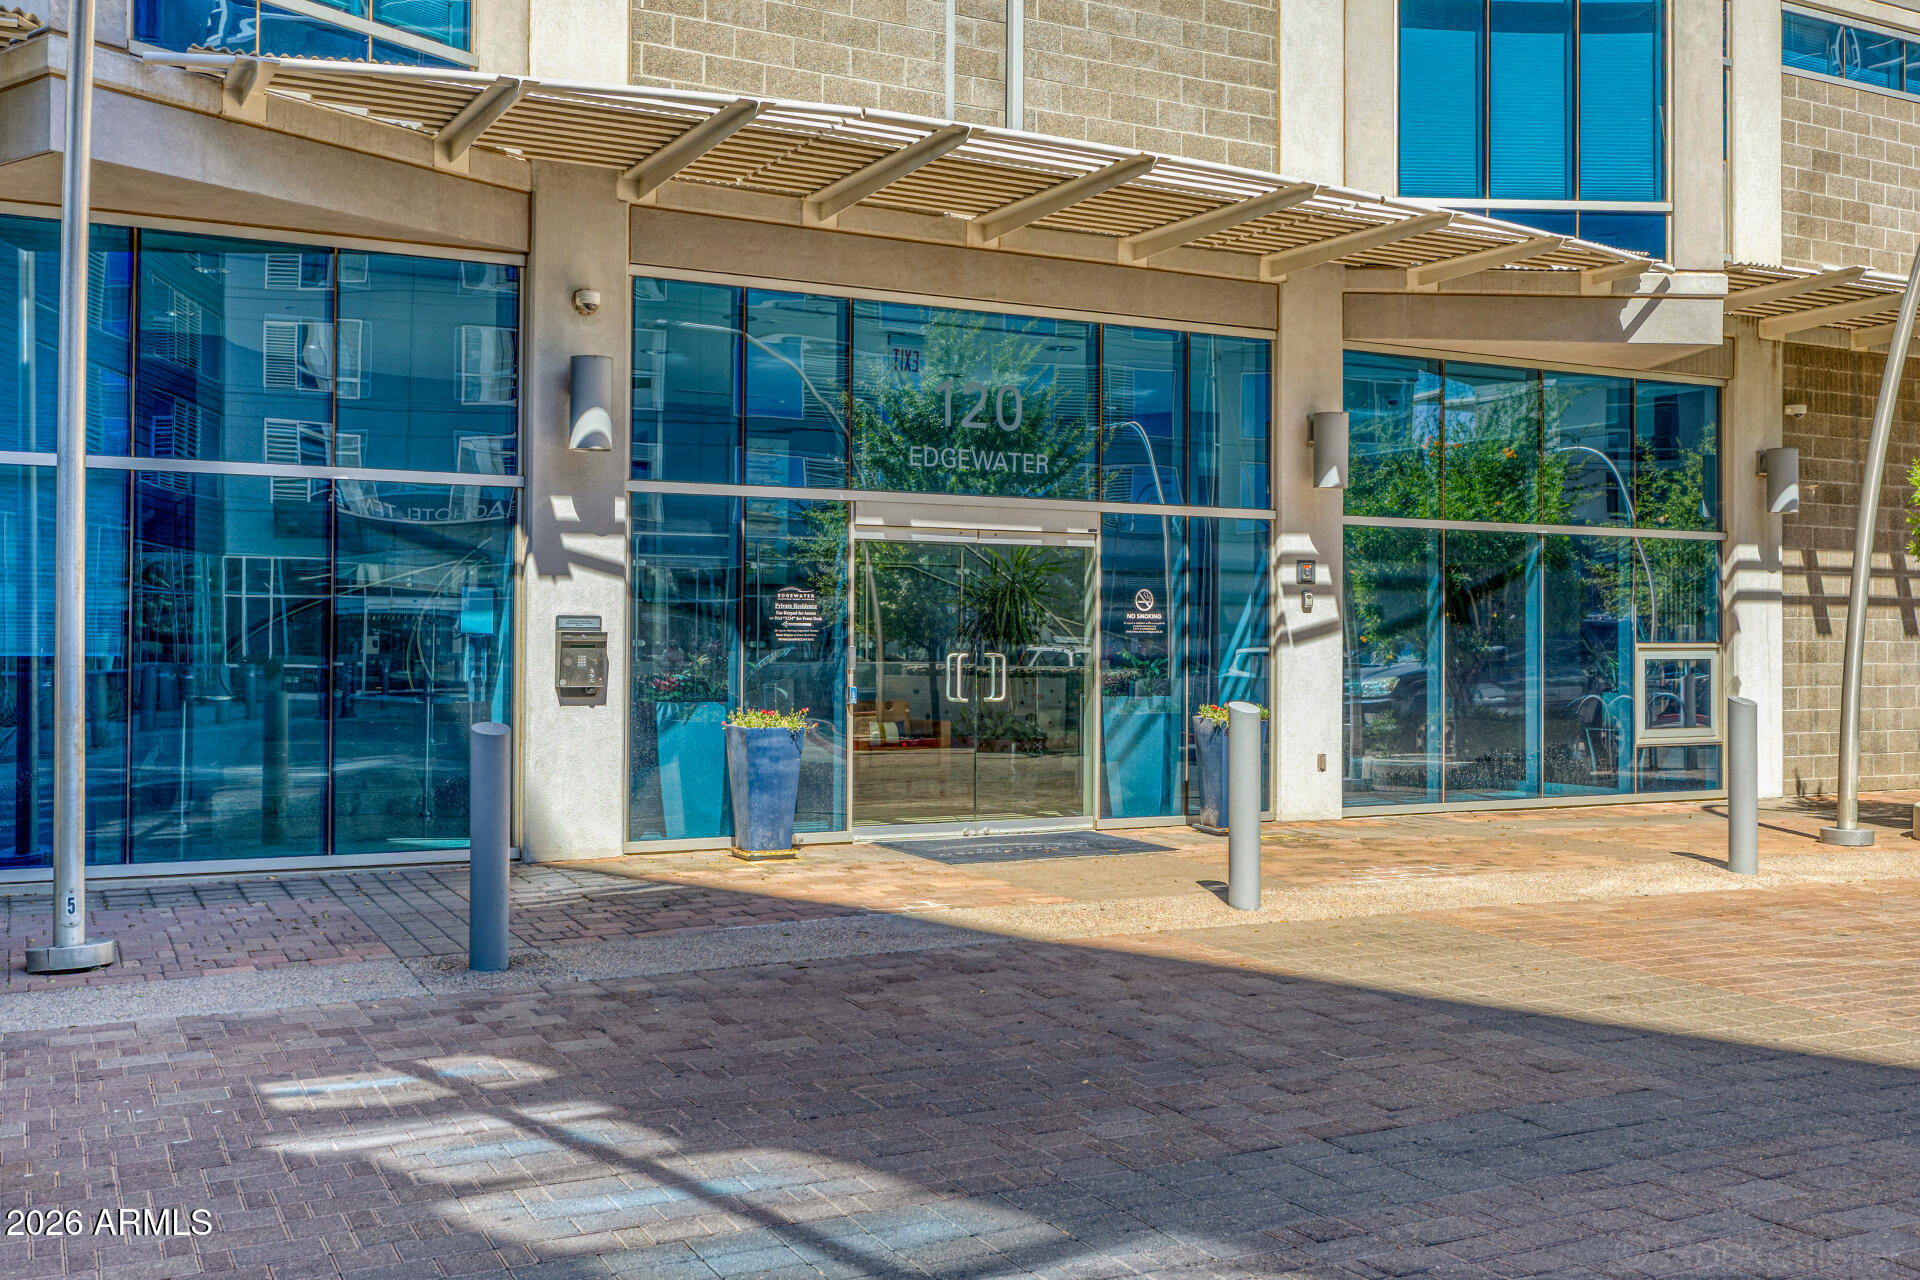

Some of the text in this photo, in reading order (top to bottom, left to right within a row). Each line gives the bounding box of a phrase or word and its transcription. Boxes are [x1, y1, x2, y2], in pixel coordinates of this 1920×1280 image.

[936, 381, 1023, 432] 120
[909, 445, 1049, 474] EDGEWATER
[67, 897, 76, 915] 5
